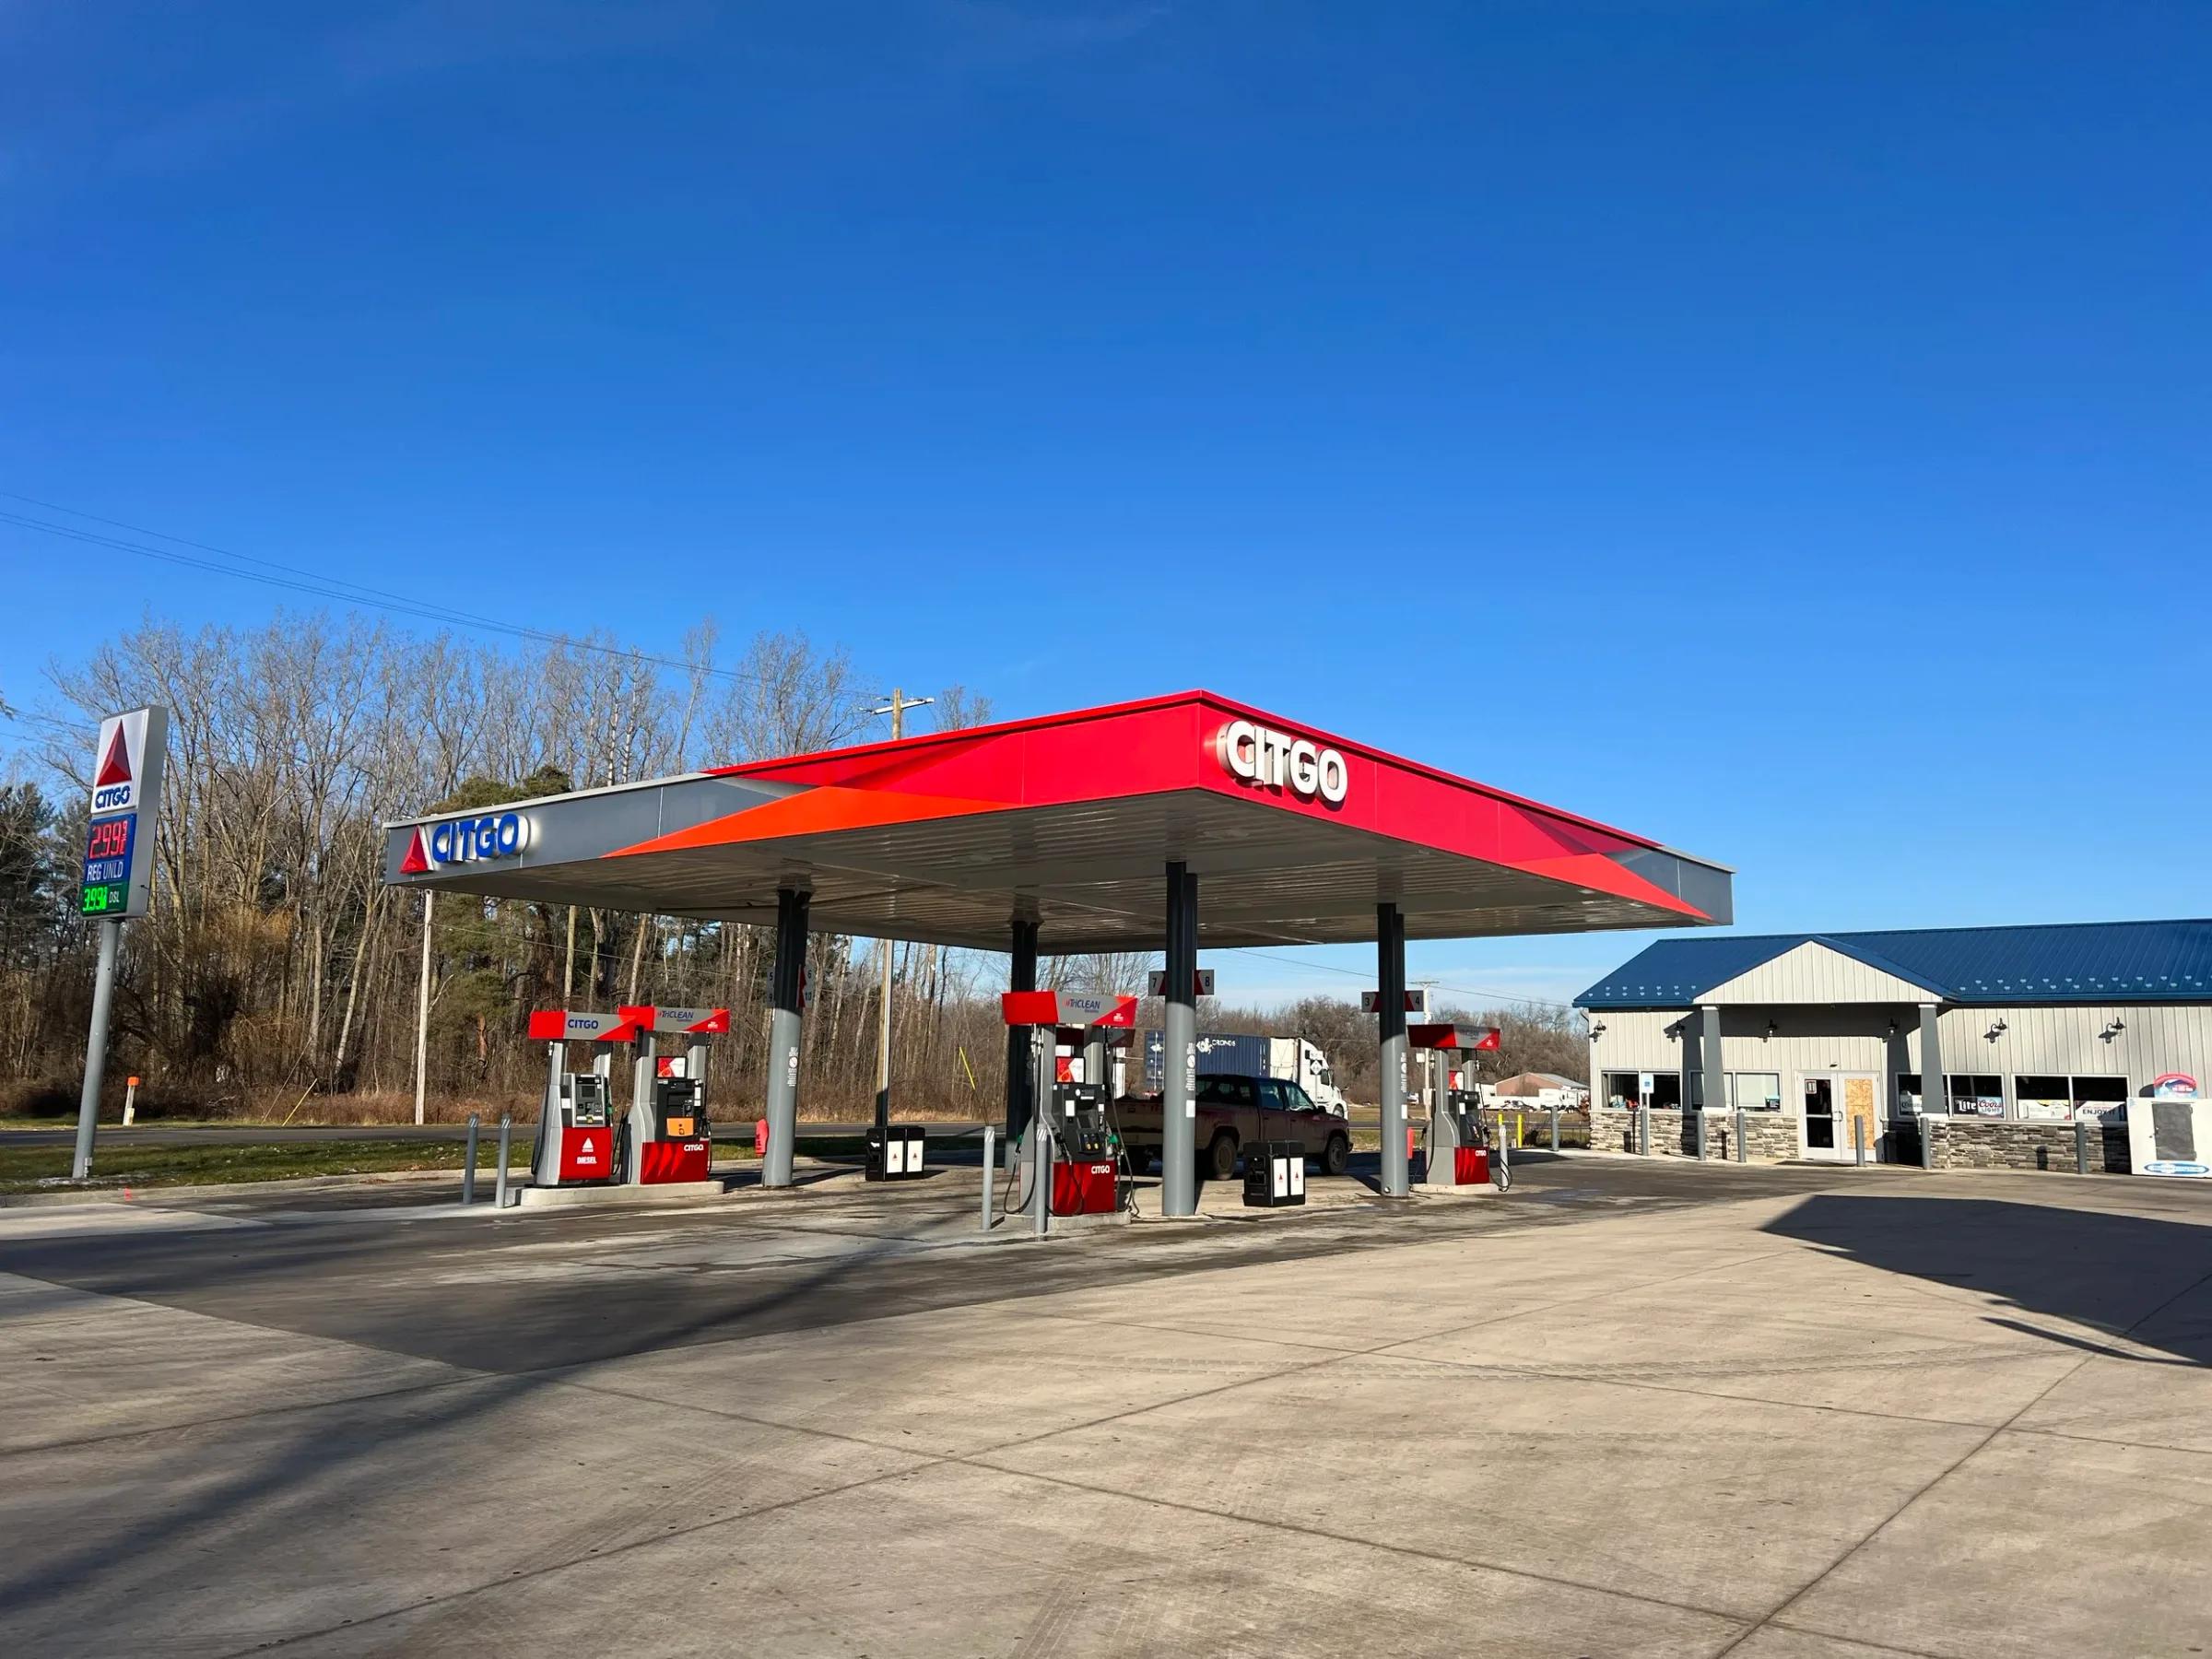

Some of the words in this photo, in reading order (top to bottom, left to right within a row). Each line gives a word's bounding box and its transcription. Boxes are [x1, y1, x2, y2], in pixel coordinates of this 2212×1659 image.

[1226, 720, 1348, 803] CITGO
[96, 785, 131, 809] CITGO
[432, 813, 521, 864] CITGO
[87, 864, 102, 882] REG
[103, 861, 124, 880] UNLD
[109, 891, 120, 903] DSL
[1152, 977, 1158, 988] 7
[1205, 977, 1210, 987] 8
[1364, 997, 1371, 1006] 3
[1415, 996, 1420, 1006] 4
[568, 1019, 599, 1030] CITGO
[1955, 1099, 1976, 1112] Lite
[1091, 1165, 1111, 1174] CITGO
